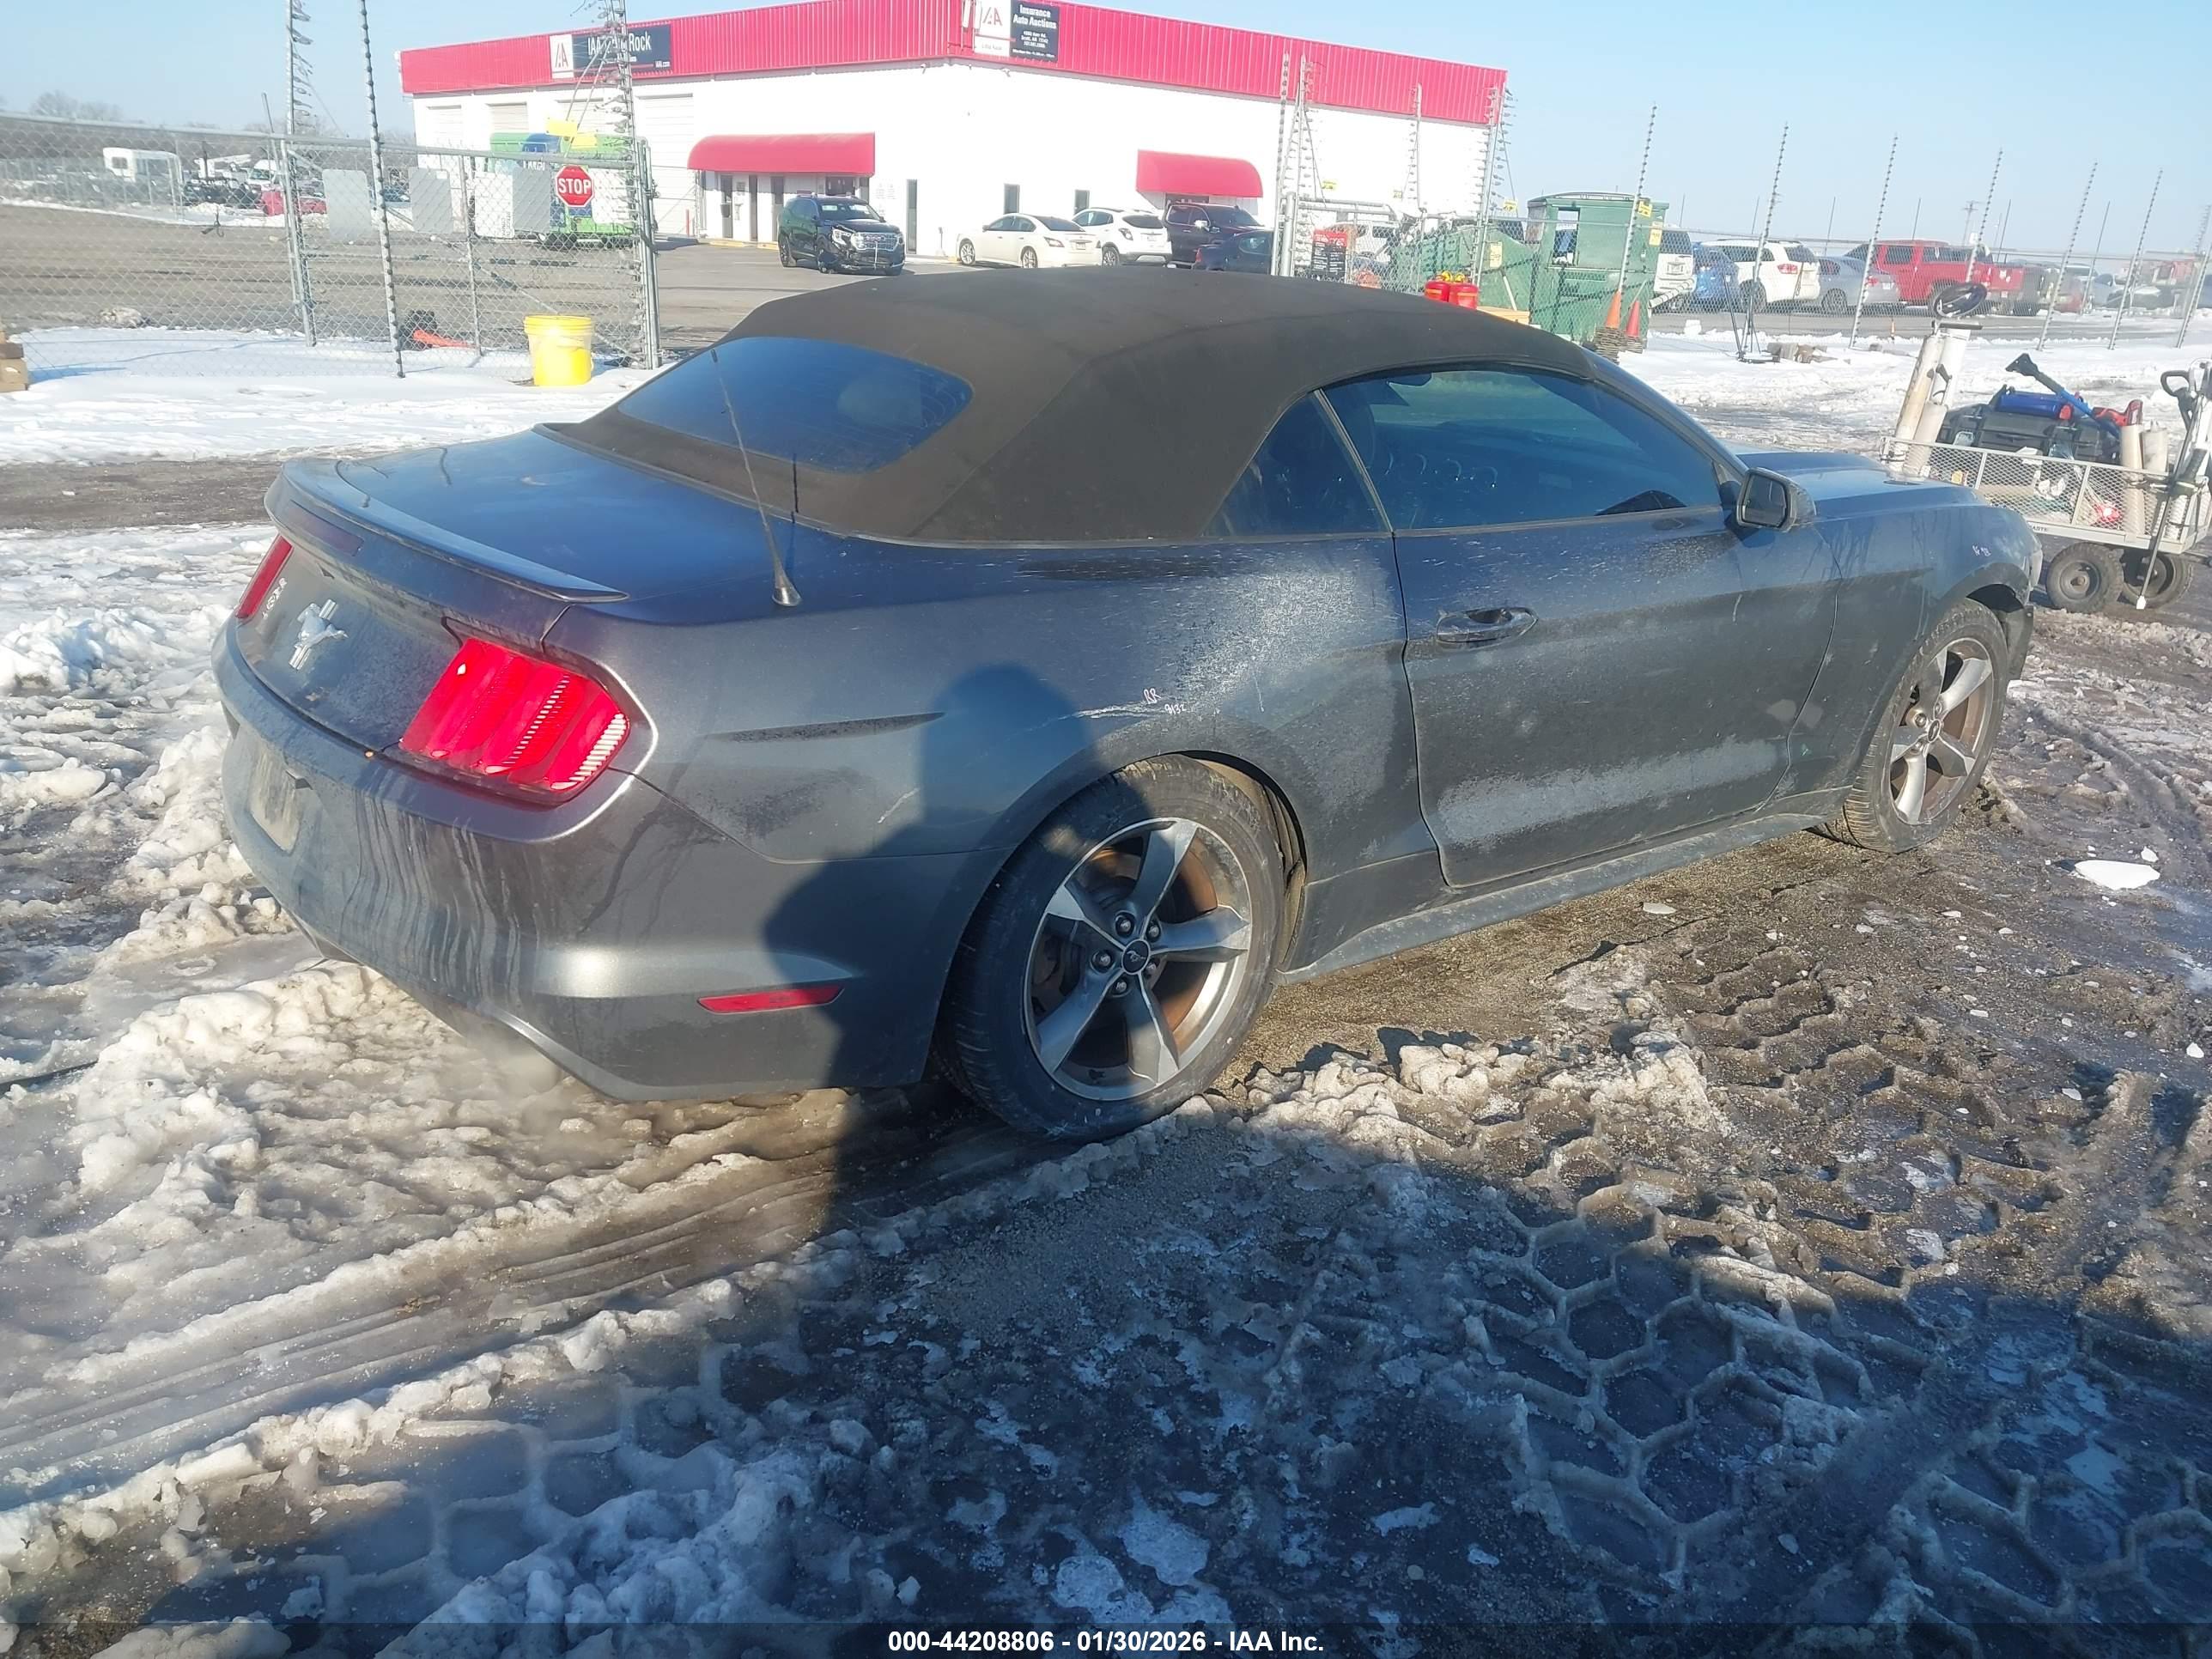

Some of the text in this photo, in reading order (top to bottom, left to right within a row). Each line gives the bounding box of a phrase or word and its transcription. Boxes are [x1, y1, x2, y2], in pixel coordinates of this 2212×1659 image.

[1019, 4, 1051, 18] Insurance
[1013, 14, 1057, 29] Auto Auctions
[629, 31, 652, 52] Rock
[558, 178, 592, 195] STOP
